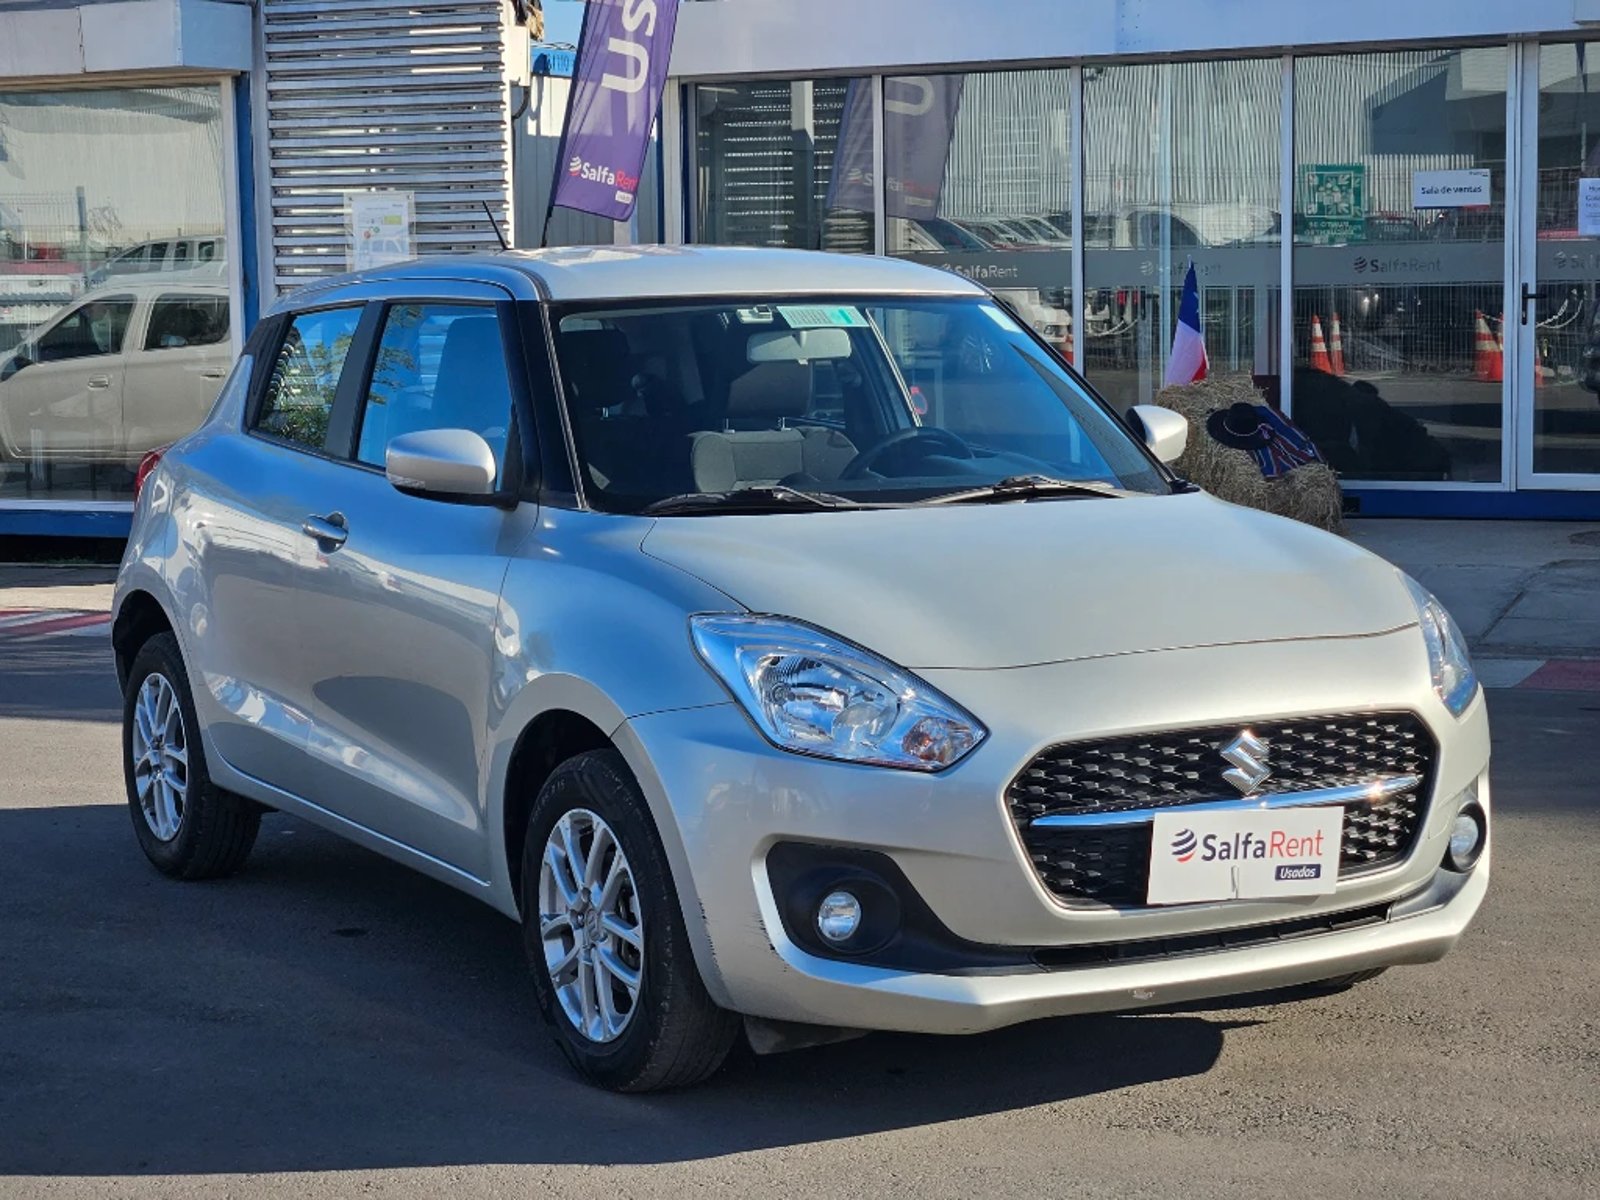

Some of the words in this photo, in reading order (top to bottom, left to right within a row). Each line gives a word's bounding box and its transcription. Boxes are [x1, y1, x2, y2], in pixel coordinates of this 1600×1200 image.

[954, 265, 1018, 278] SalfaRent
[1201, 829, 1324, 862] SalfaRent
[1279, 865, 1317, 880] Usados
